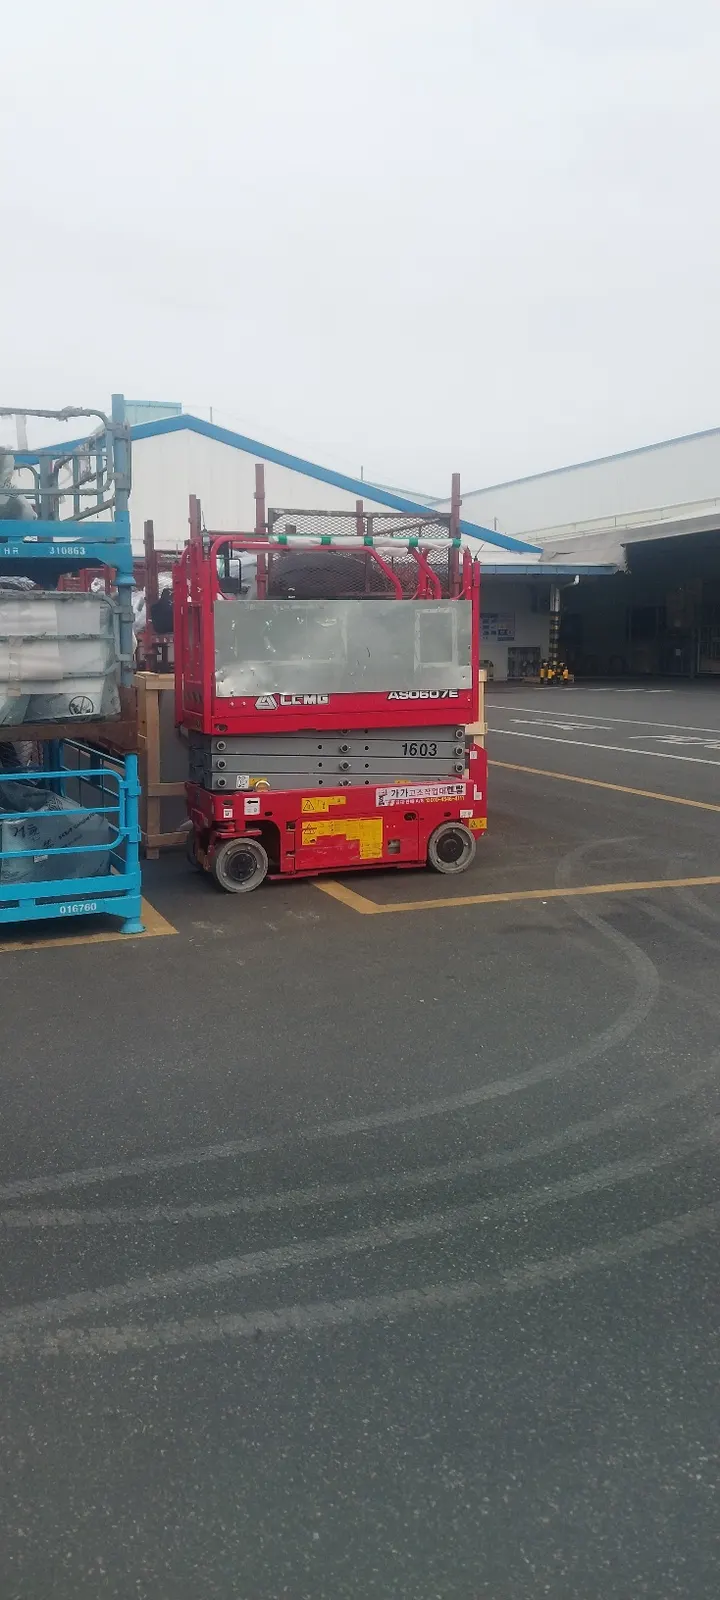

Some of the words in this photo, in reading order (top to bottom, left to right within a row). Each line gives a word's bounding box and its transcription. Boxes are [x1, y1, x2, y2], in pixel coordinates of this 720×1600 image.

[50, 546, 86, 555] 310863
[402, 743, 438, 757] 1603
[60, 903, 97, 914] 016760
